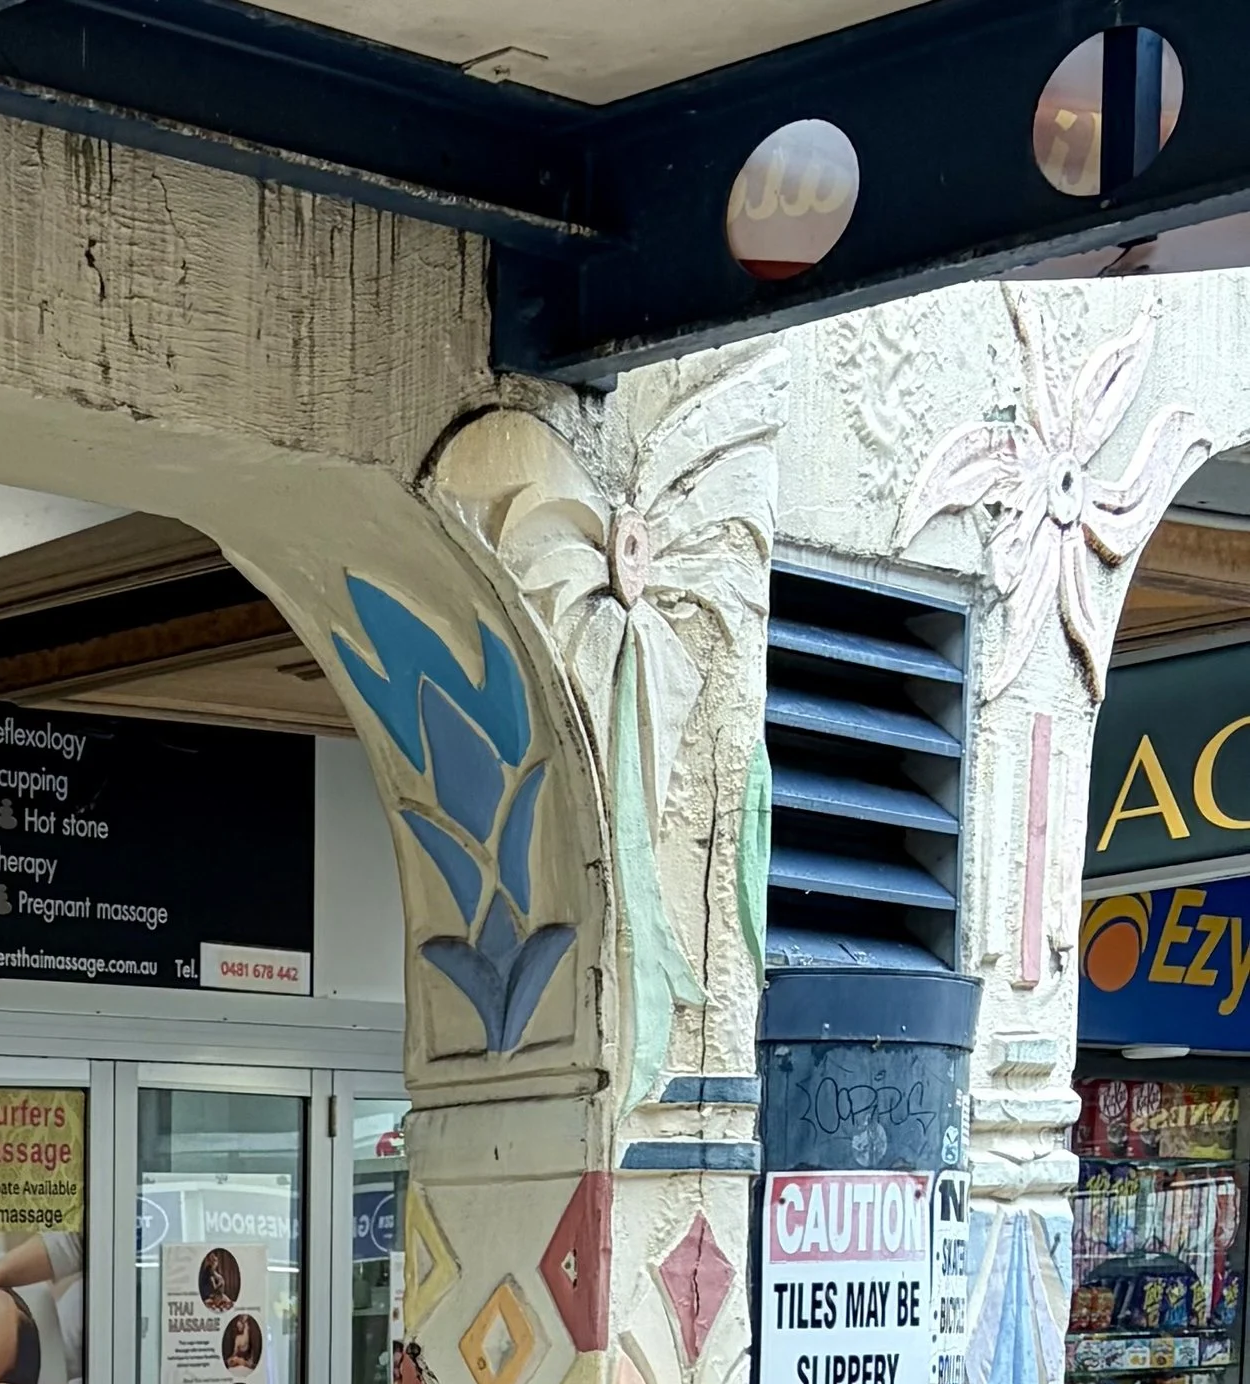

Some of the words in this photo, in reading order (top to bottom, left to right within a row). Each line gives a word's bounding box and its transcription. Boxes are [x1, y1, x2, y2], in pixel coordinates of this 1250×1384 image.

[24, 808, 56, 834] Hot
[62, 814, 109, 839] stone
[18, 890, 90, 923] Pregnant
[97, 899, 168, 930] massage
[175, 959, 198, 979] Tel.
[220, 960, 249, 978] 0481
[253, 964, 274, 980] 678
[277, 965, 299, 983] 442
[23, 1180, 77, 1196] Available
[777, 1181, 923, 1256] CAUTION
[167, 1301, 195, 1317] THAI
[773, 1282, 838, 1330] TILES
[845, 1280, 892, 1328] MAY
[897, 1280, 921, 1327] BE
[167, 1318, 221, 1333] MASSAGE
